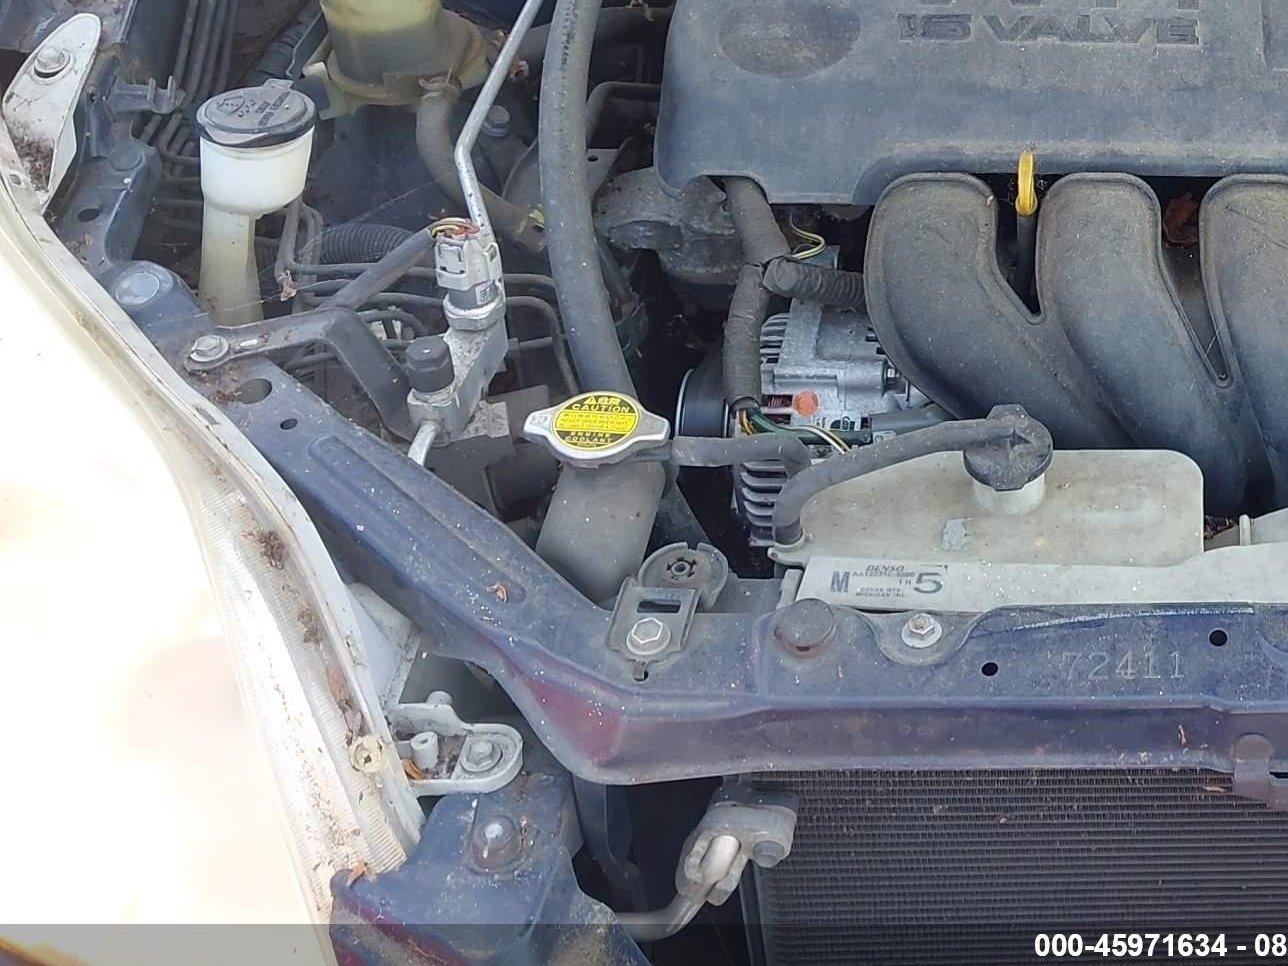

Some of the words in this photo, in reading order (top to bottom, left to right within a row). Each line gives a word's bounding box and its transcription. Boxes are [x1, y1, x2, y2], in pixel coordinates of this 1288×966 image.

[982, 13, 1201, 46] VALVE
[571, 403, 630, 413] CAUTION
[866, 564, 905, 572] DENSO
[829, 570, 851, 594] M
[913, 571, 944, 595] 5
[1062, 650, 1185, 681] 72411
